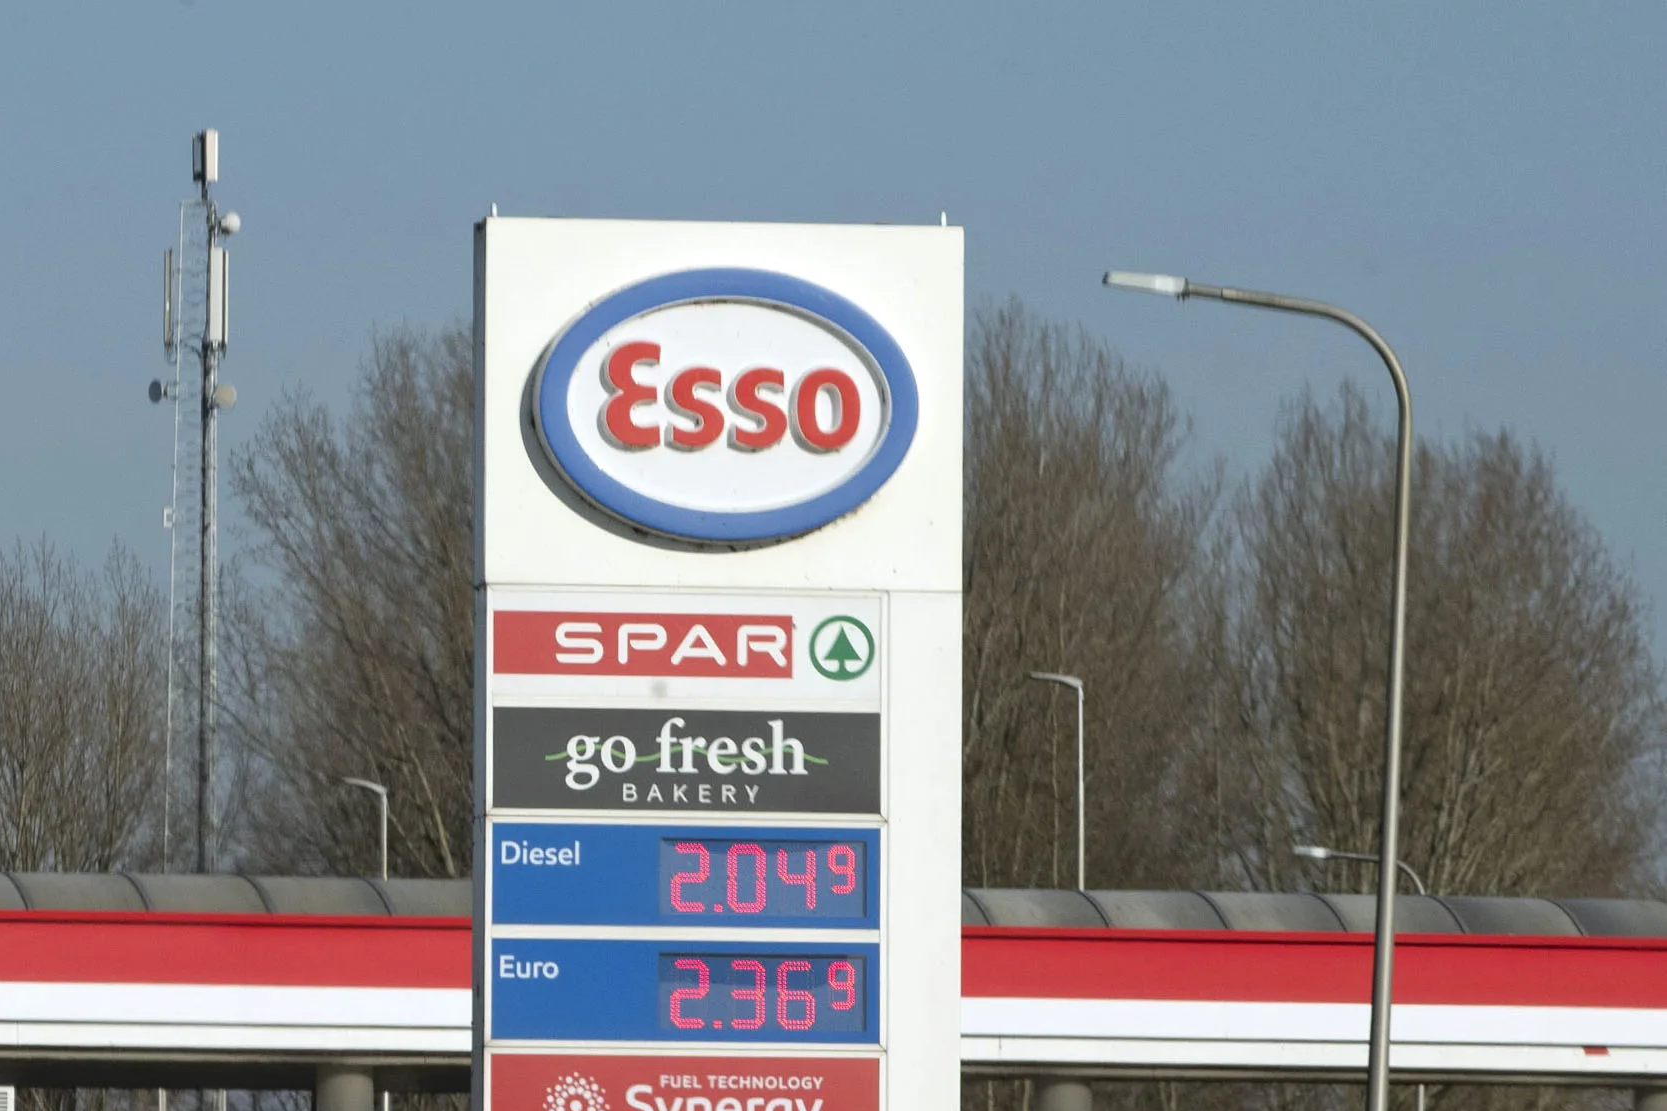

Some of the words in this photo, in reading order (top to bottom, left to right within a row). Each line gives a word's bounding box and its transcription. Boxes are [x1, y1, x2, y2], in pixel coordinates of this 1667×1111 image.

[554, 622, 789, 667] SPAR
[564, 733, 637, 790] go
[655, 717, 809, 776] fresh
[622, 783, 761, 804] BAKERY
[499, 840, 581, 866] Diesel
[498, 954, 560, 980] Euro
[659, 1074, 702, 1089] FUEL
[707, 1074, 824, 1091] TECHNOLOGY
